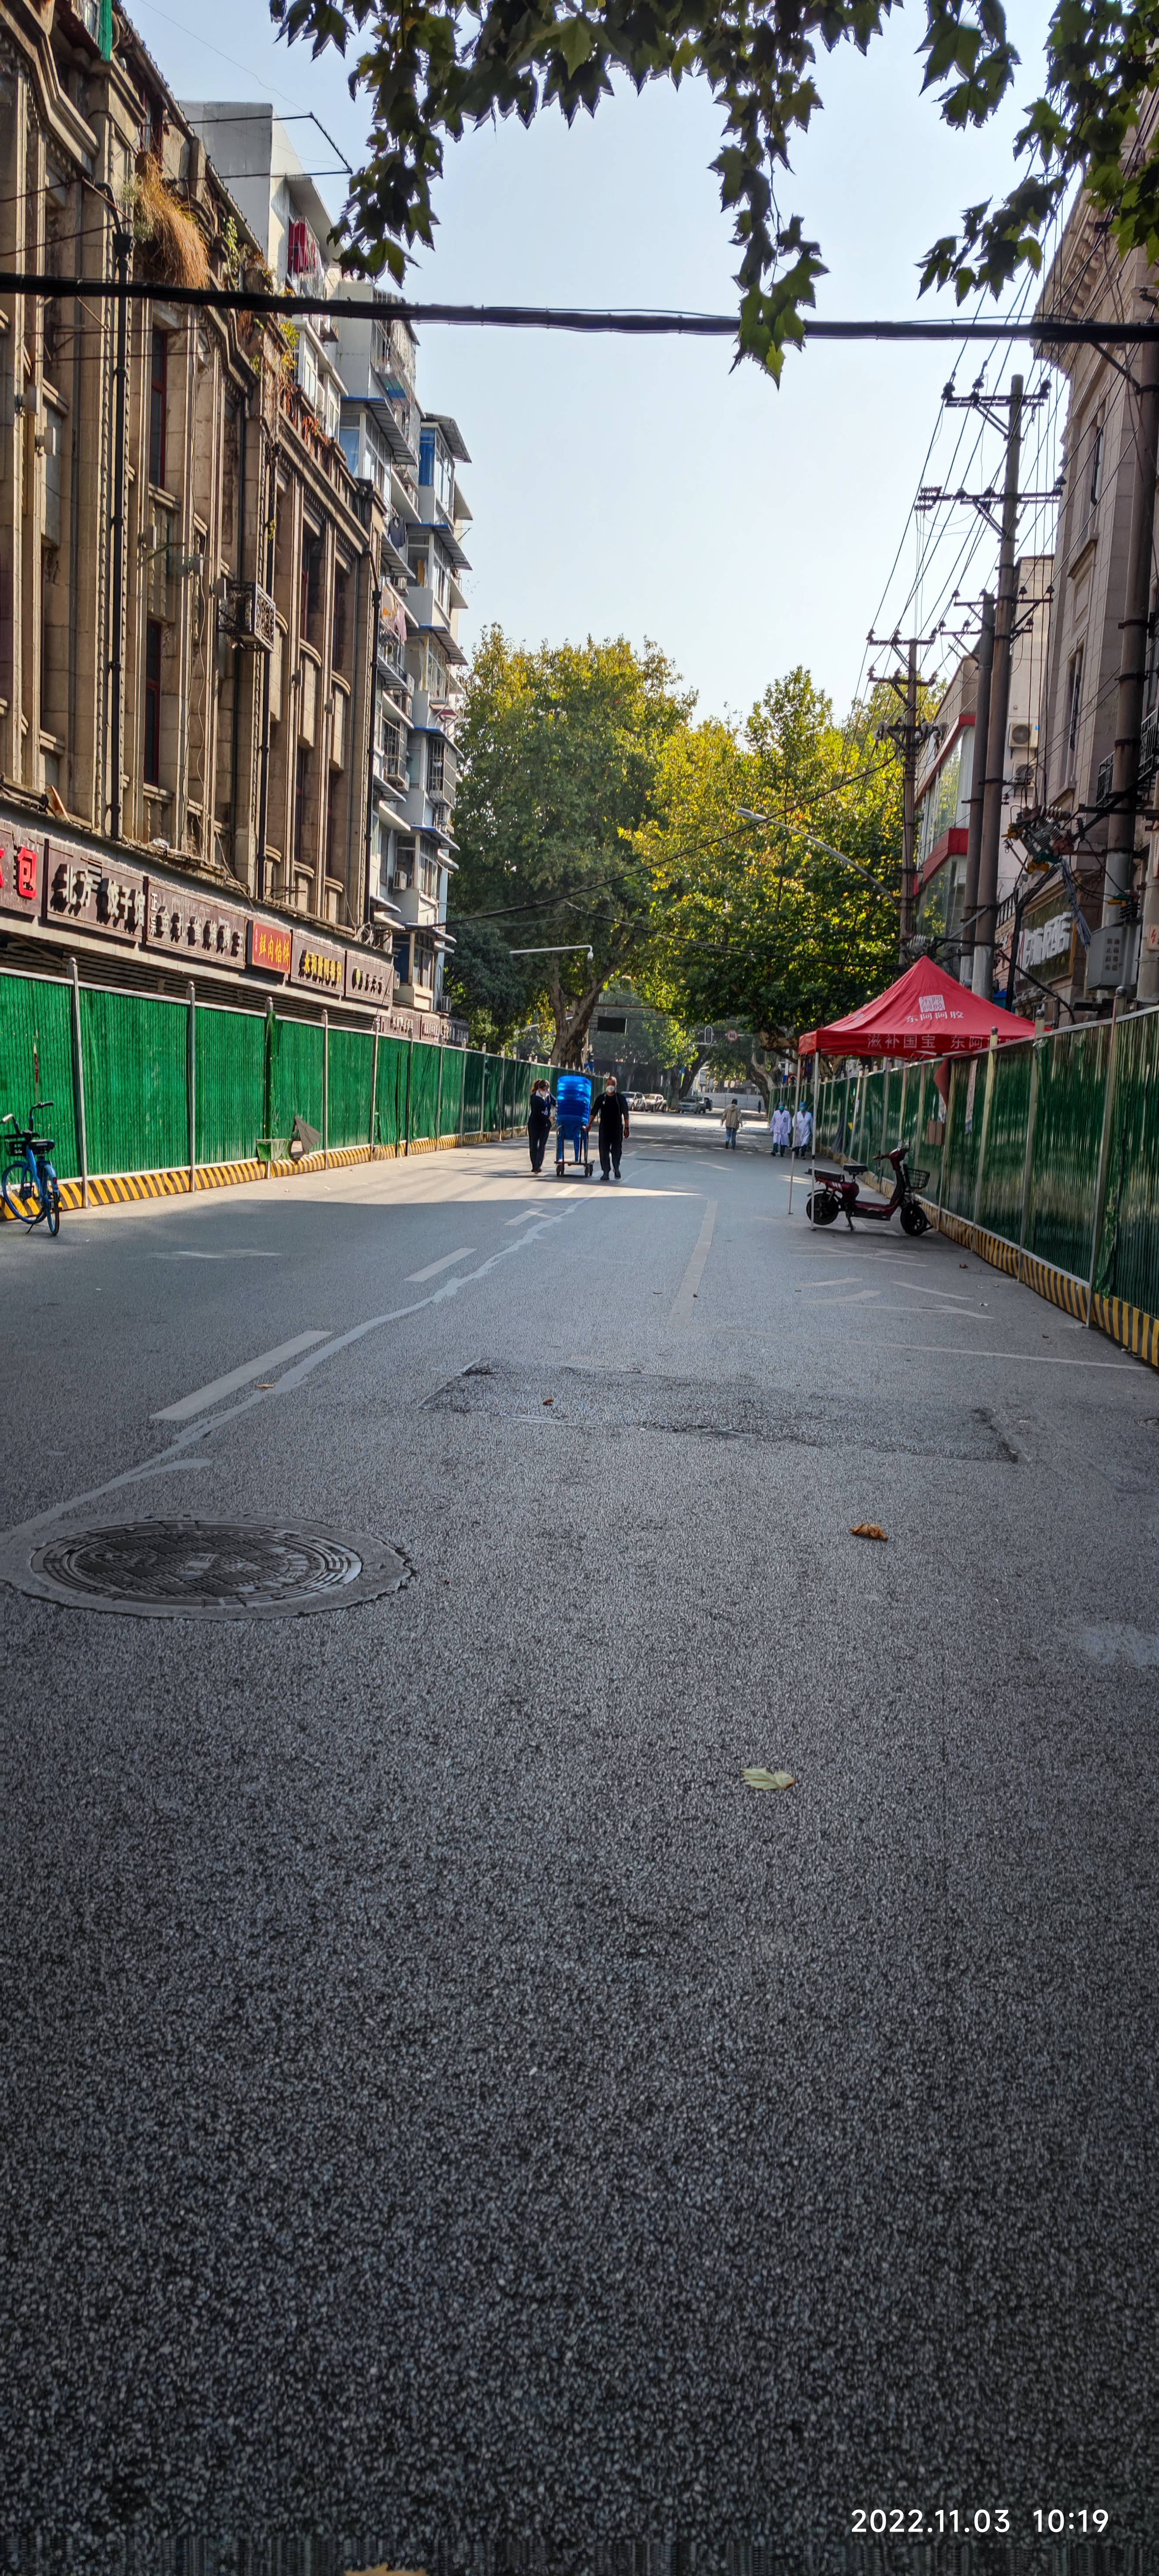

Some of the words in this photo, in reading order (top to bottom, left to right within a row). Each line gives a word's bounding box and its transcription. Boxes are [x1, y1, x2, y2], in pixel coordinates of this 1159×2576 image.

[58, 863, 145, 927] 北方饺子馆
[151, 893, 157, 938] 正宗
[258, 932, 290, 967] 鲜肉馅饼
[906, 1011, 964, 1023] 东阿阿胶
[867, 1033, 936, 1049] 滋补国宝
